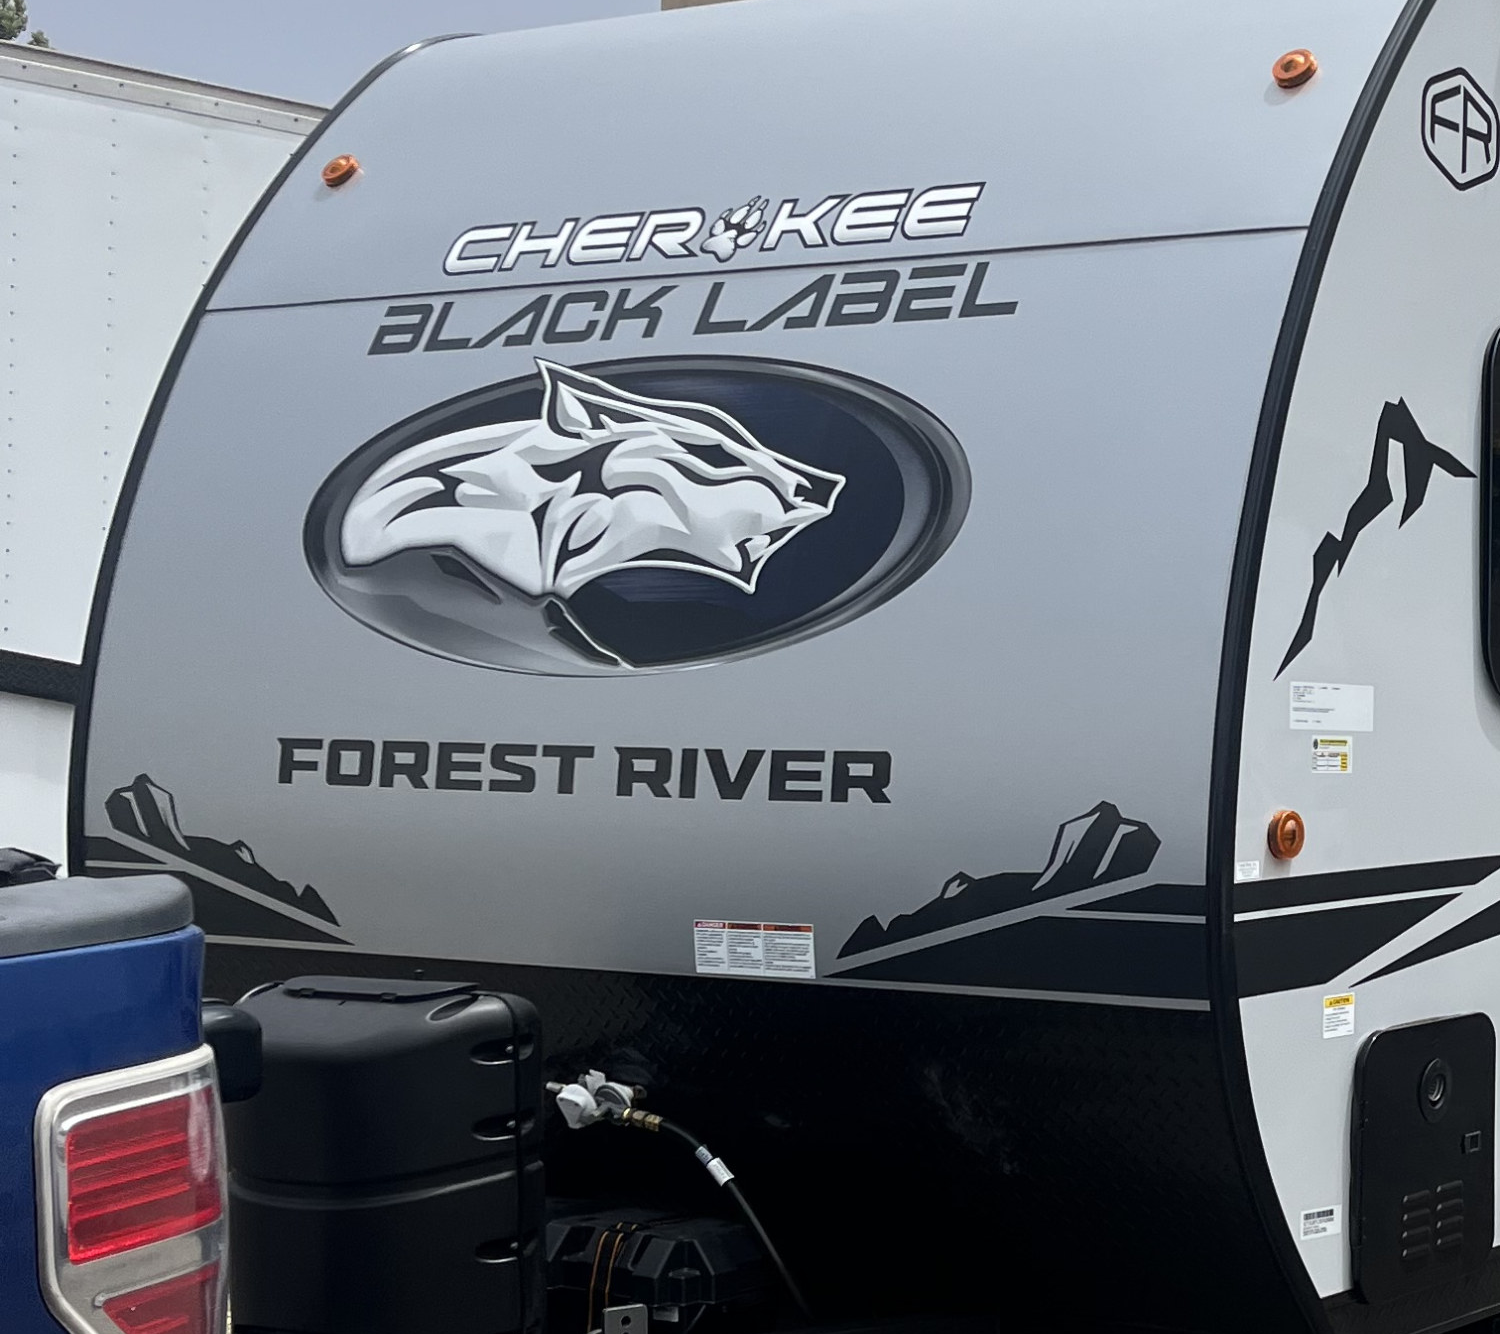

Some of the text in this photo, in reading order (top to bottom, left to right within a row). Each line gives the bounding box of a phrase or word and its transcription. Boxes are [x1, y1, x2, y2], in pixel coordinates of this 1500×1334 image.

[367, 261, 1019, 356] BLACK LABEL
[276, 737, 893, 804] FOREST RIVER
